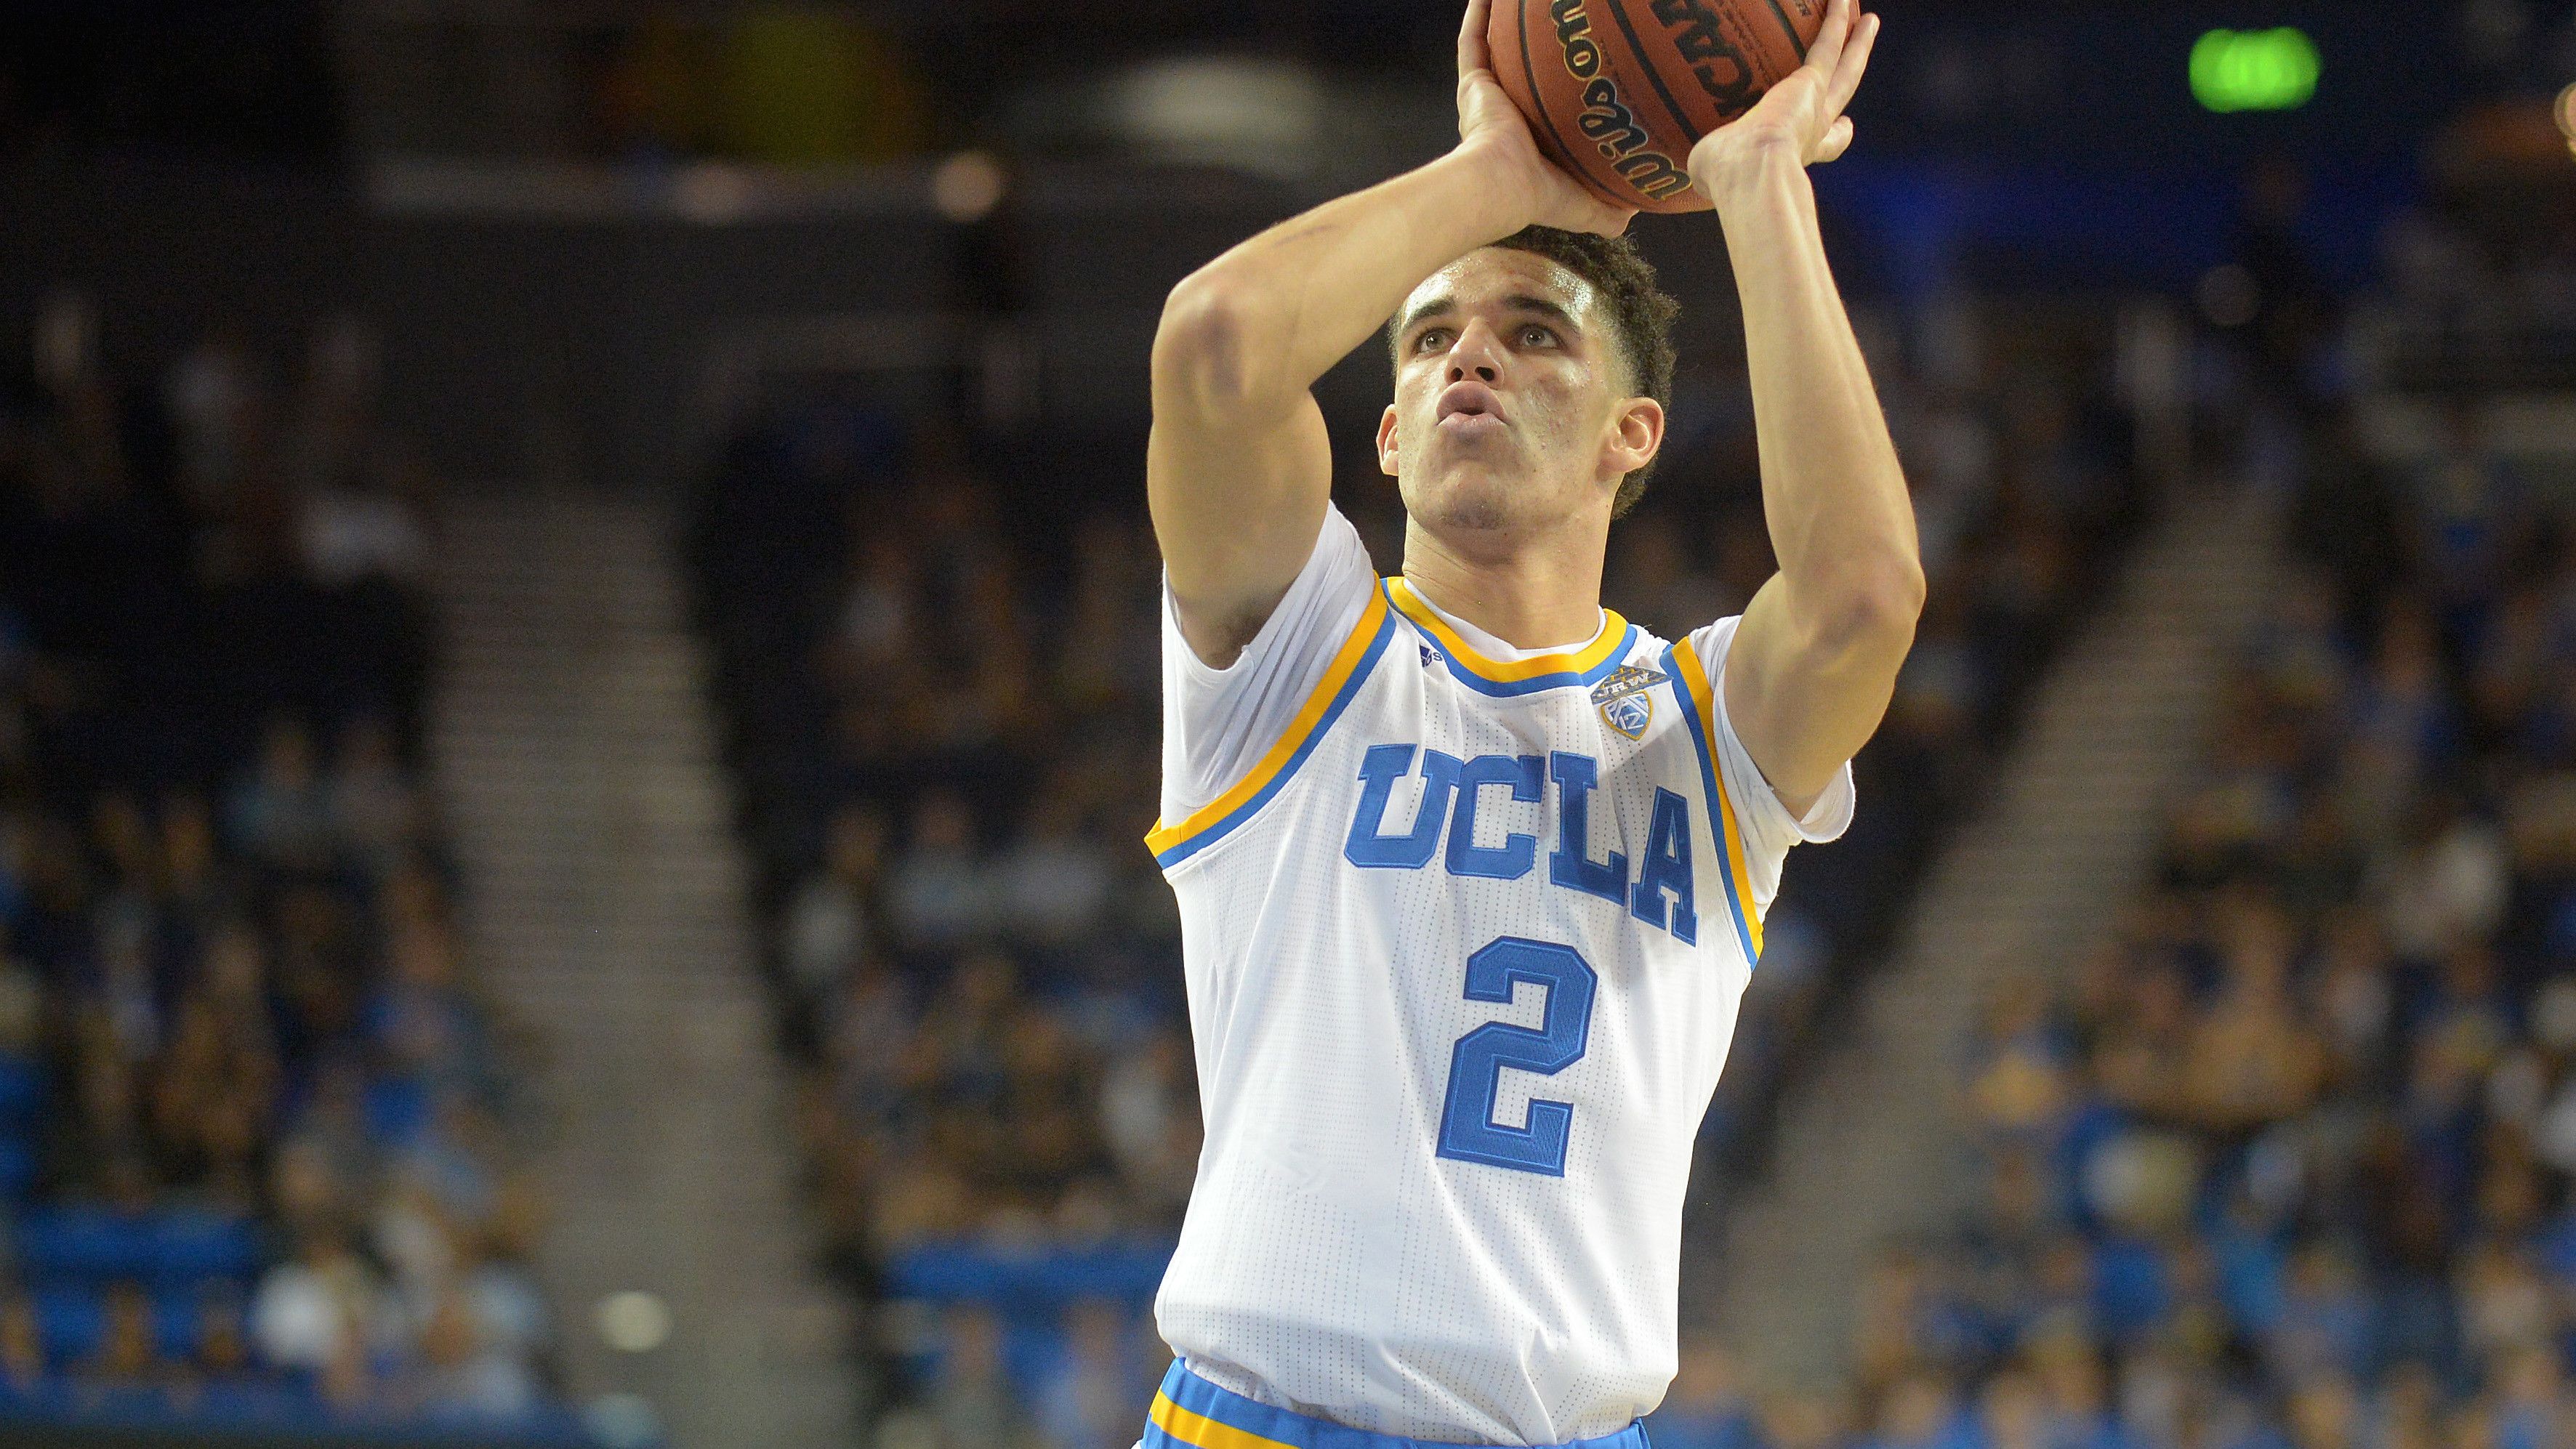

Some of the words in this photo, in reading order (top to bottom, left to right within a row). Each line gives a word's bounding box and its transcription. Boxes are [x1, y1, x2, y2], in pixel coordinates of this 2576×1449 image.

[1550, 0, 1691, 200] Wilson
[1344, 743, 1697, 947] UCLA
[1436, 935, 1598, 1178] 2
